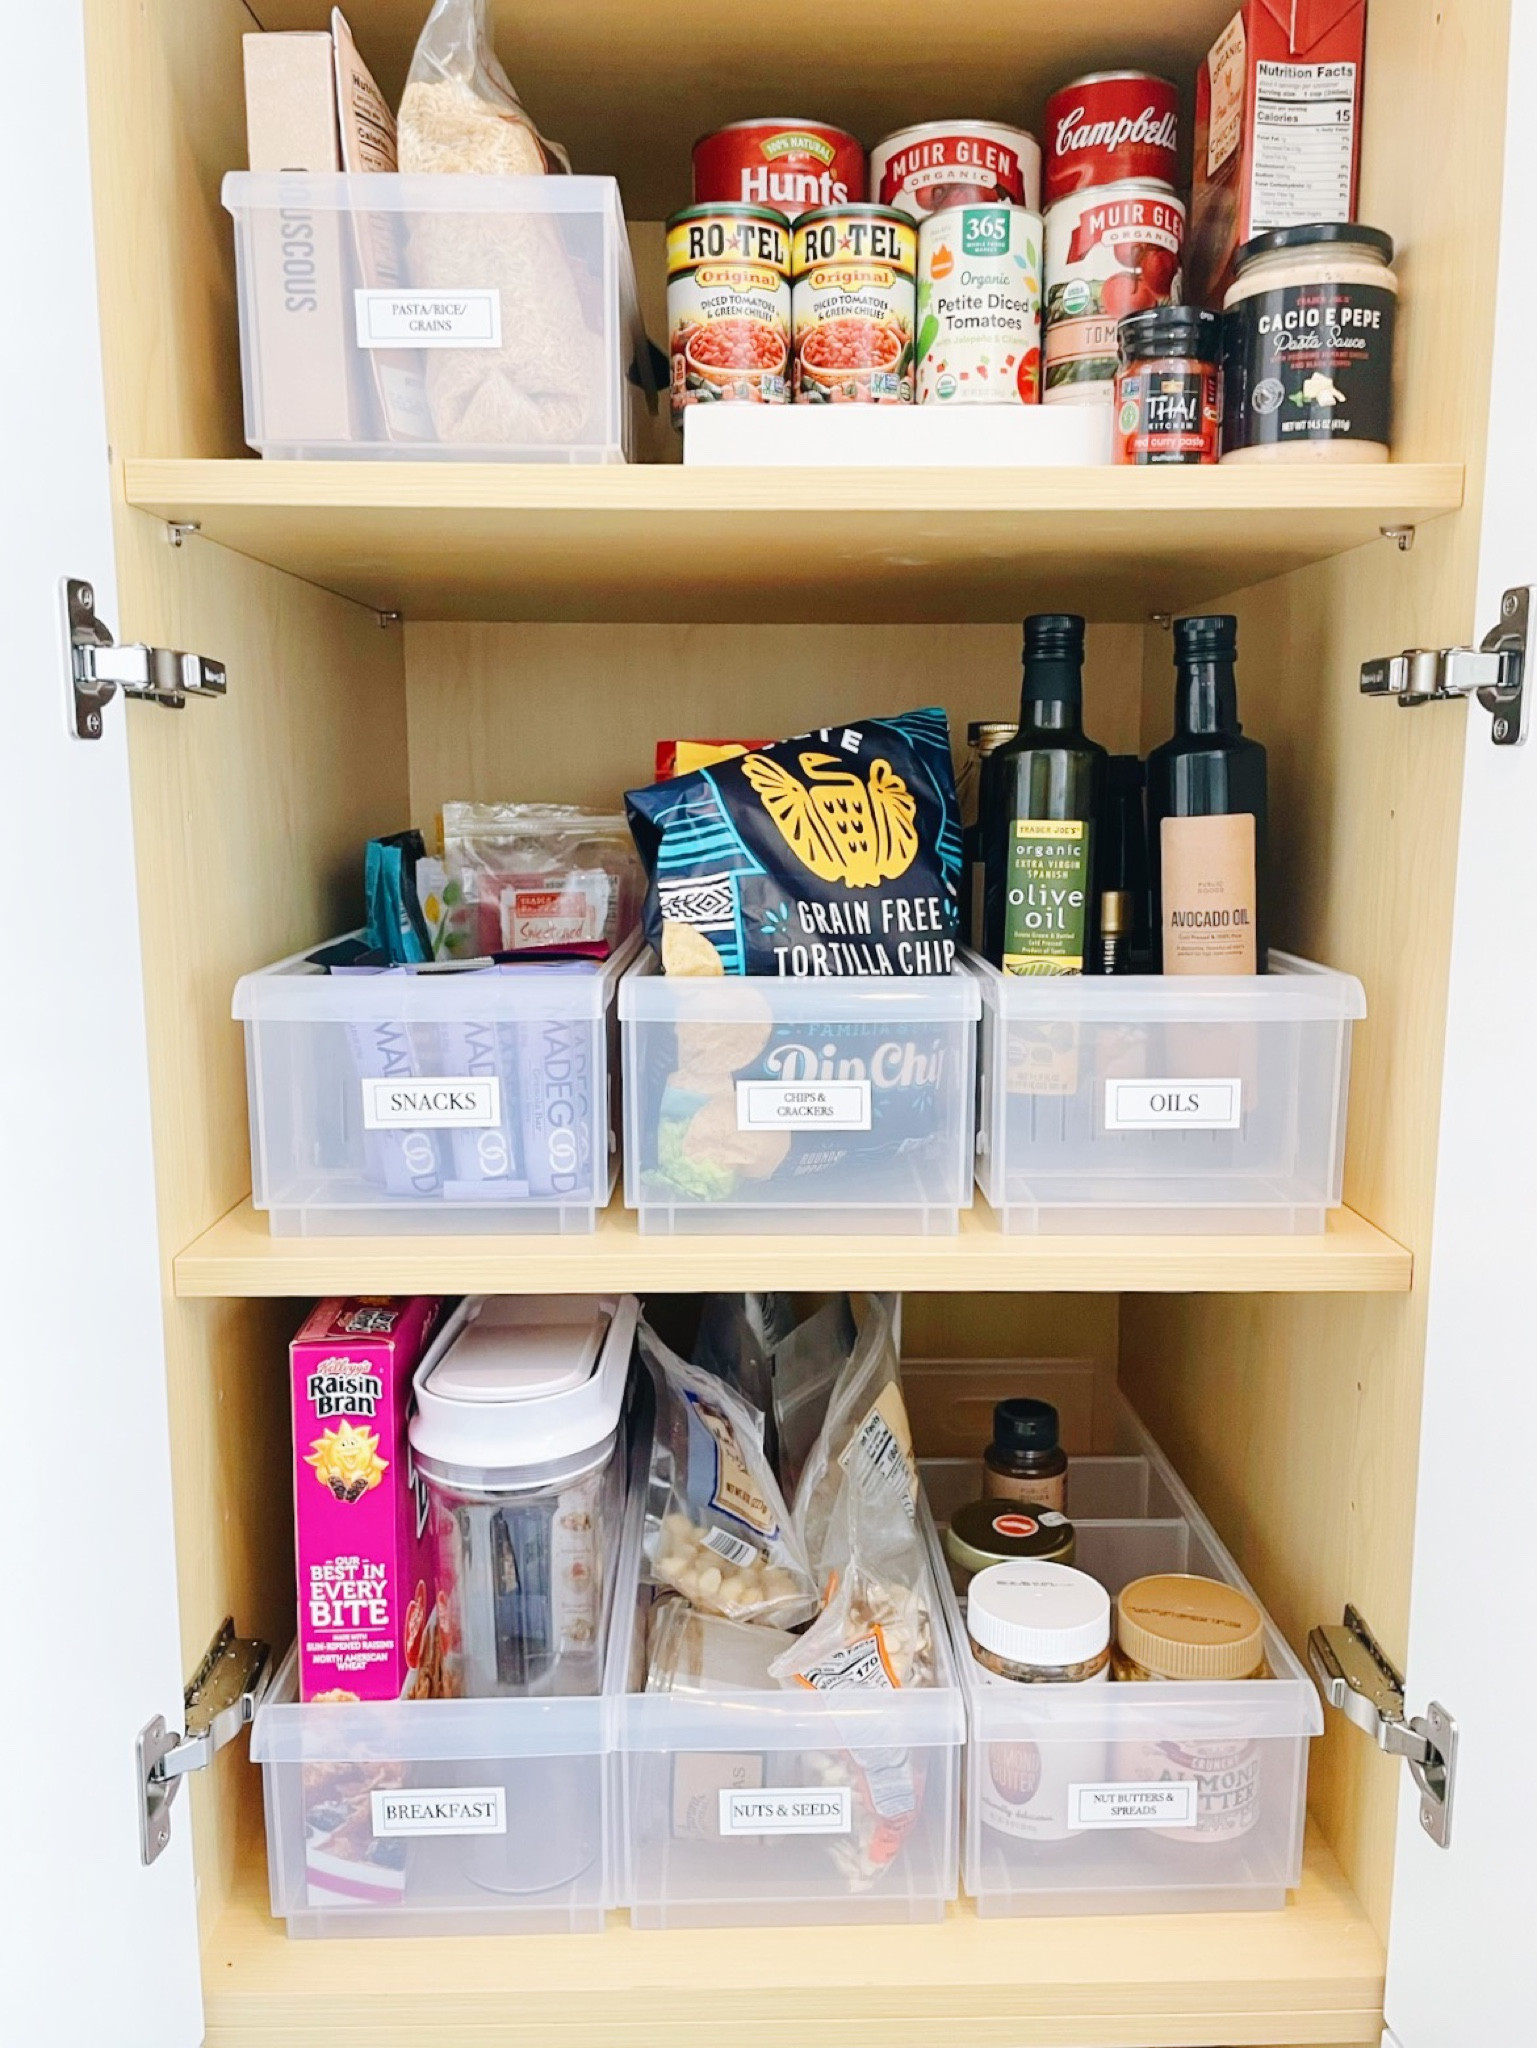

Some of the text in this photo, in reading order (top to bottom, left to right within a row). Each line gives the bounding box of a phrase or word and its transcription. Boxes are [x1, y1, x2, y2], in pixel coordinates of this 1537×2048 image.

[1259, 63, 1353, 79] Nutrition Facts
[1257, 109, 1351, 122] Calories 15
[1056, 106, 1178, 157] Campbell's
[790, 137, 831, 160] NATURAL
[892, 141, 1011, 182] MUIR GLEN
[911, 170, 989, 186] ORGANIC
[966, 216, 1006, 240] 365
[1089, 204, 1144, 235] MUIR
[702, 270, 775, 286] Original
[815, 270, 889, 285] Original
[960, 270, 1011, 289] Organic
[392, 303, 469, 316] PASTA/RICE/
[714, 306, 743, 317] GREEN
[825, 306, 852, 319] GREEN
[938, 294, 1030, 314] Petite Diced
[409, 320, 453, 332] GRAINS
[945, 314, 1022, 331] Tomatoes
[1258, 307, 1382, 335] CACIO E PEPE
[1273, 330, 1323, 357] Pasta
[1326, 325, 1367, 349] Sauce
[1145, 395, 1197, 421] THAI
[1148, 421, 1194, 430] KITCHEN
[1151, 438, 1176, 449] curry
[1178, 436, 1205, 448] paste
[1019, 826, 1052, 834] TRADER
[1016, 843, 1082, 858] organic
[1015, 859, 1081, 869] EXTRA VIRGIN
[1026, 869, 1069, 880] SPANISH
[1008, 884, 1084, 908] olive
[797, 897, 943, 935] GRAIN FREE
[1024, 907, 1065, 930] oil
[1171, 908, 1251, 928] AVOCADO OIL
[773, 942, 894, 976] TORTILLA
[390, 1092, 477, 1111] SNACKS
[784, 1092, 827, 1103] CHIPS &
[1149, 1093, 1200, 1113] OILS
[777, 1106, 834, 1117] CRACKERS
[310, 1376, 380, 1398] Raisin
[319, 1396, 373, 1415] Bran
[335, 1556, 360, 1567] OUR
[310, 1563, 386, 1581] BEST IN
[310, 1580, 388, 1600] EVERY
[309, 1599, 390, 1627] BITE
[362, 1640, 395, 1650] RAISINS
[312, 1652, 389, 1665] NORTH AMERICAN
[336, 1661, 368, 1672] WHEAT
[856, 1656, 878, 1678] 170
[1094, 1792, 1175, 1804] NUT BUTTERS &
[386, 1802, 495, 1821] BREAKFAST
[733, 1802, 841, 1818] NUTS & SEEDS
[1111, 1805, 1157, 1816] SPREADS
